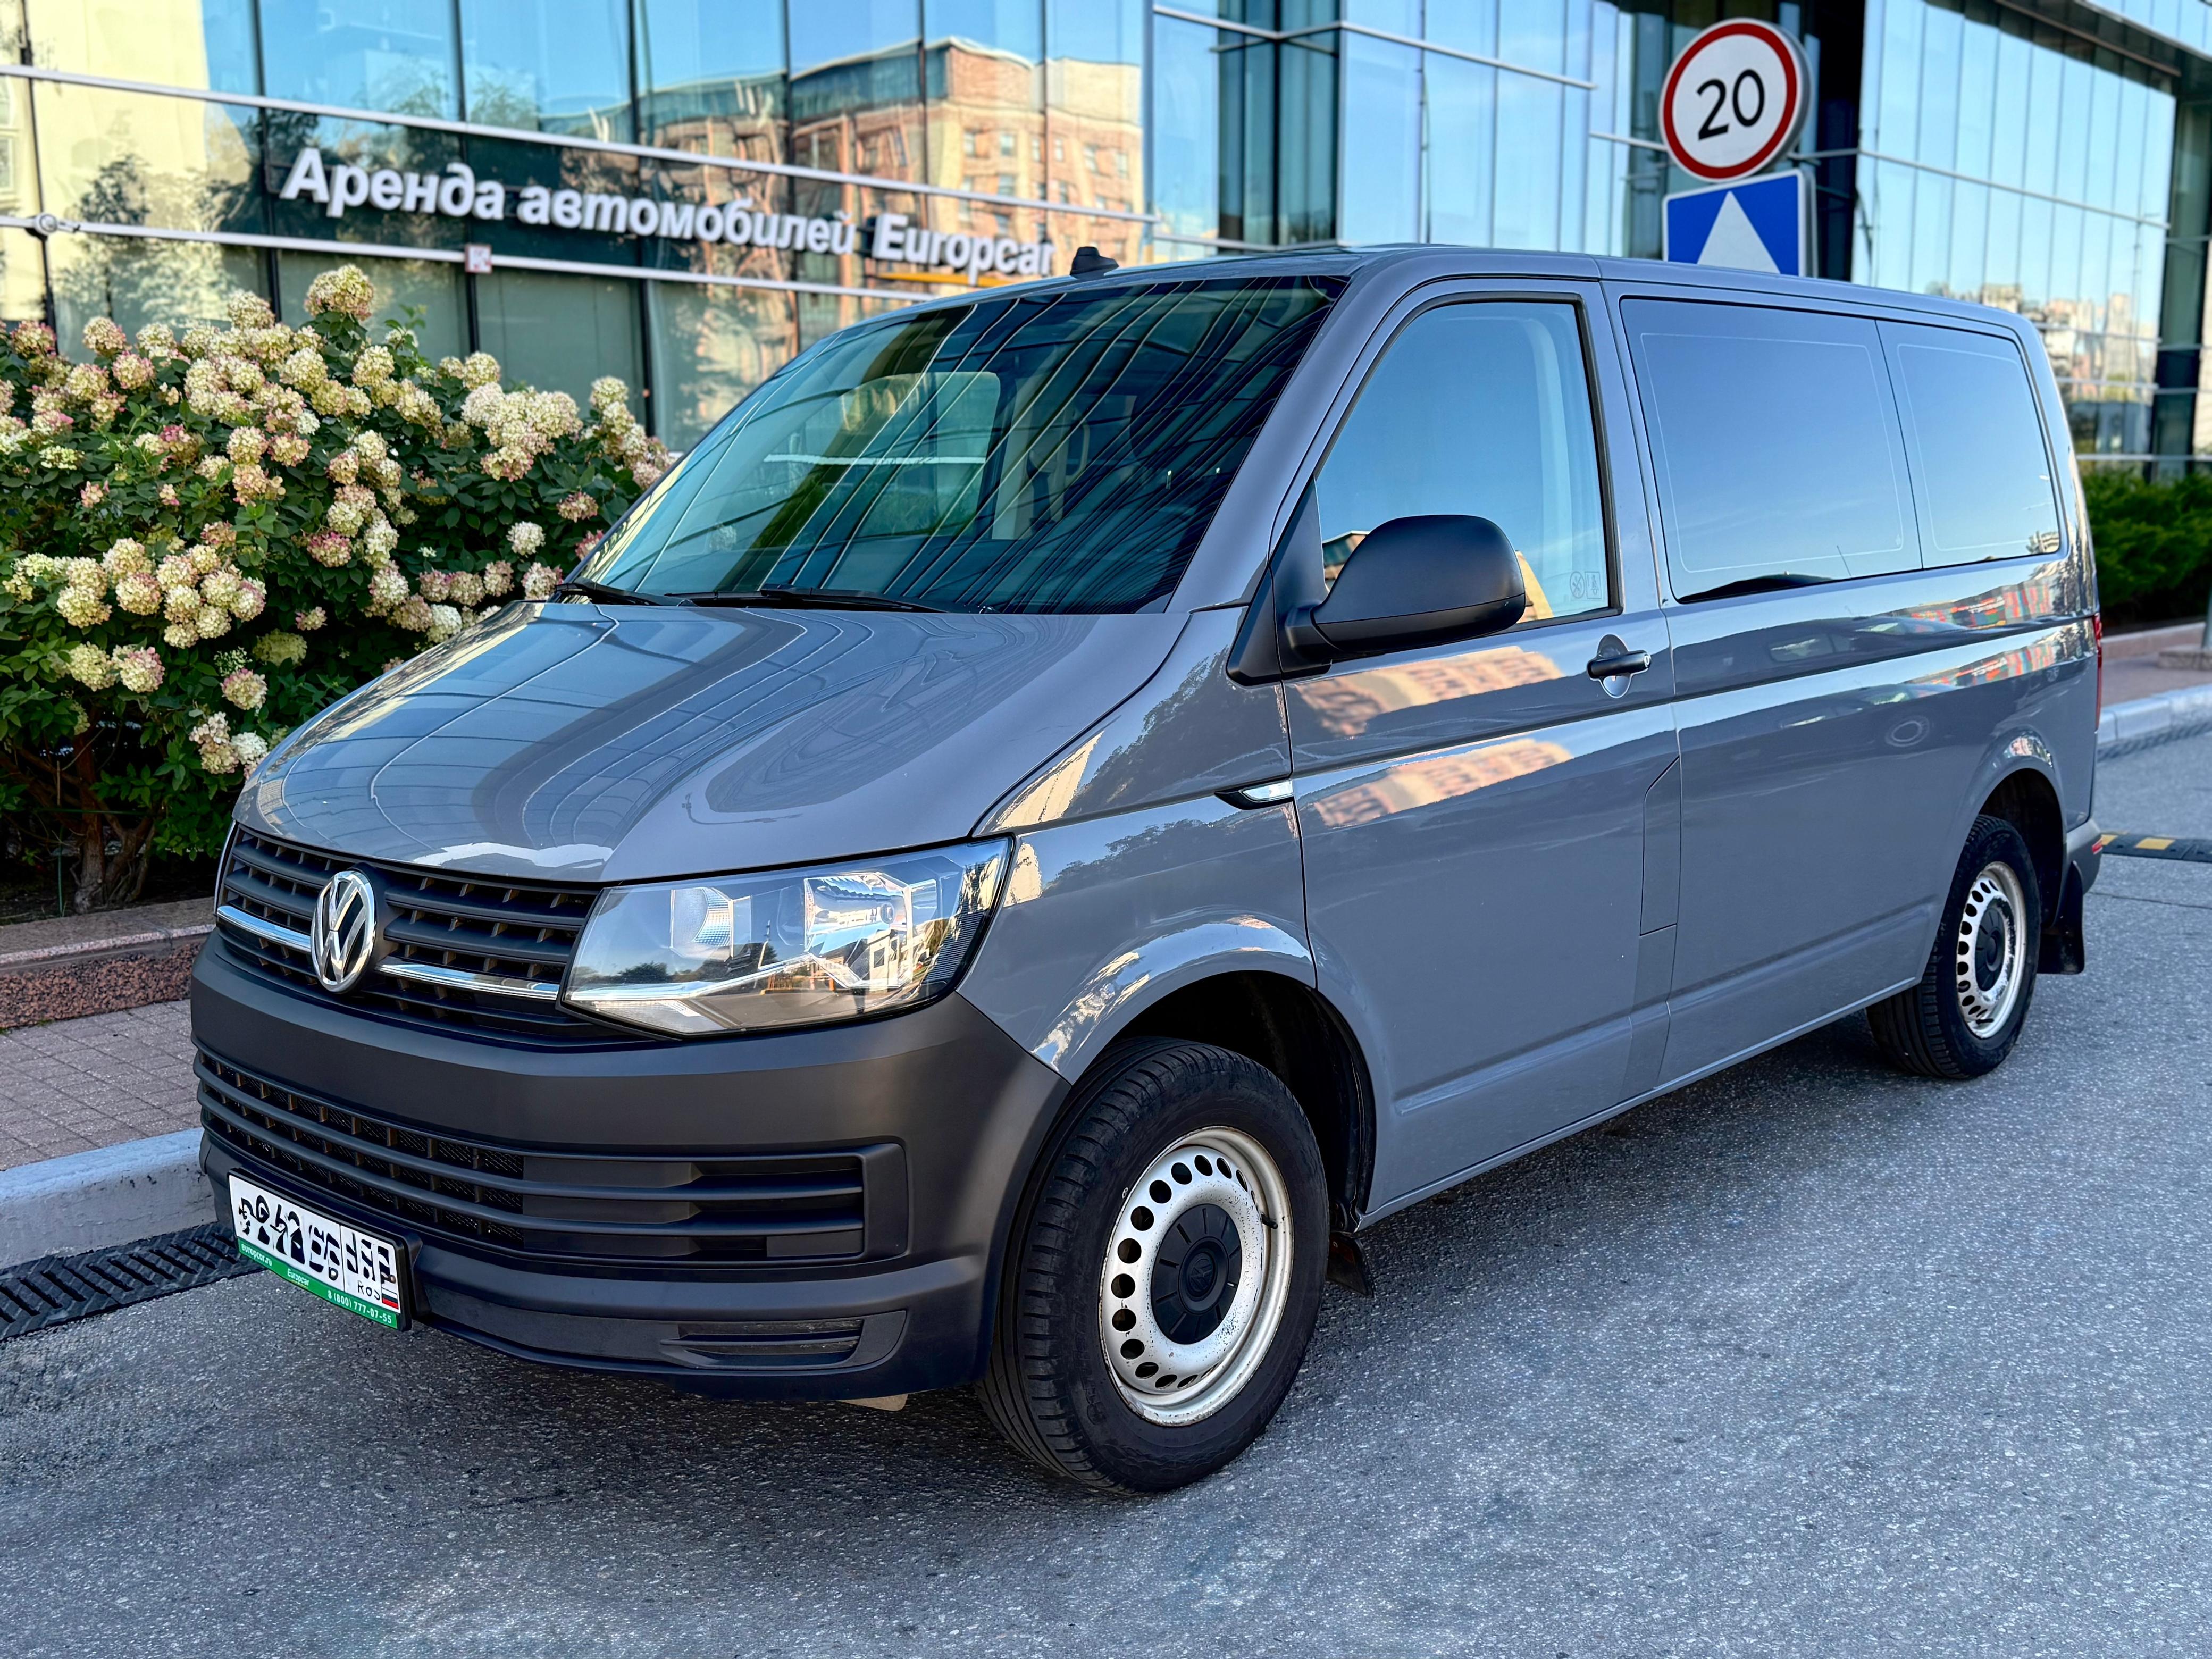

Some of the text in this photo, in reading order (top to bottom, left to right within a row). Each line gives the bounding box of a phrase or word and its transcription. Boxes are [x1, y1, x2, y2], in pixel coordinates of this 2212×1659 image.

[1696, 69, 1765, 141] 20
[279, 147, 1055, 286] Аренда автомобилей Europcar
[241, 1243, 272, 1267] europcar.ru
[287, 1268, 309, 1286] Europcar
[328, 1289, 392, 1324] 8 (800) 777-07-55
